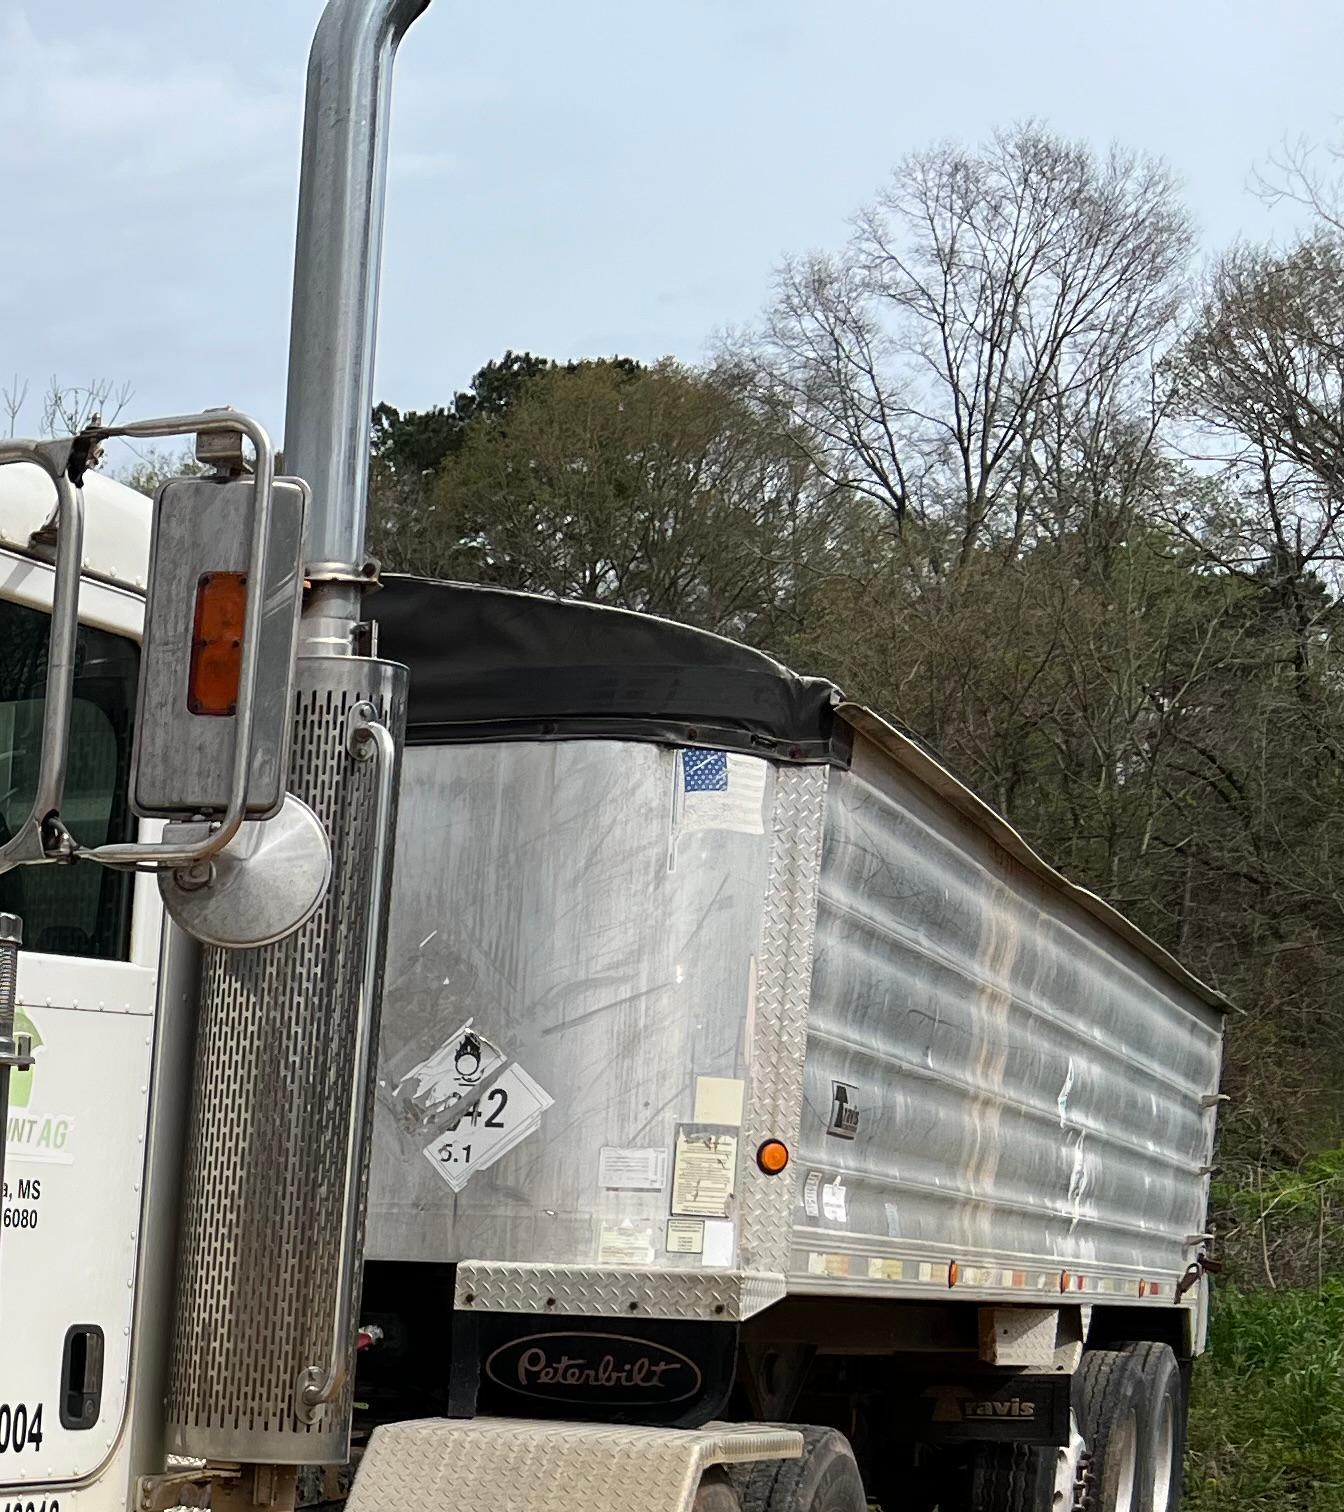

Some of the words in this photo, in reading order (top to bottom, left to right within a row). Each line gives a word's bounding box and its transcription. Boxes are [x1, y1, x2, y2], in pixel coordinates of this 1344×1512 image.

[36, 1120, 69, 1148] AG
[17, 1179, 41, 1200] MS
[3, 1208, 38, 1229] 6080
[518, 1348, 681, 1388] Peterbilt
